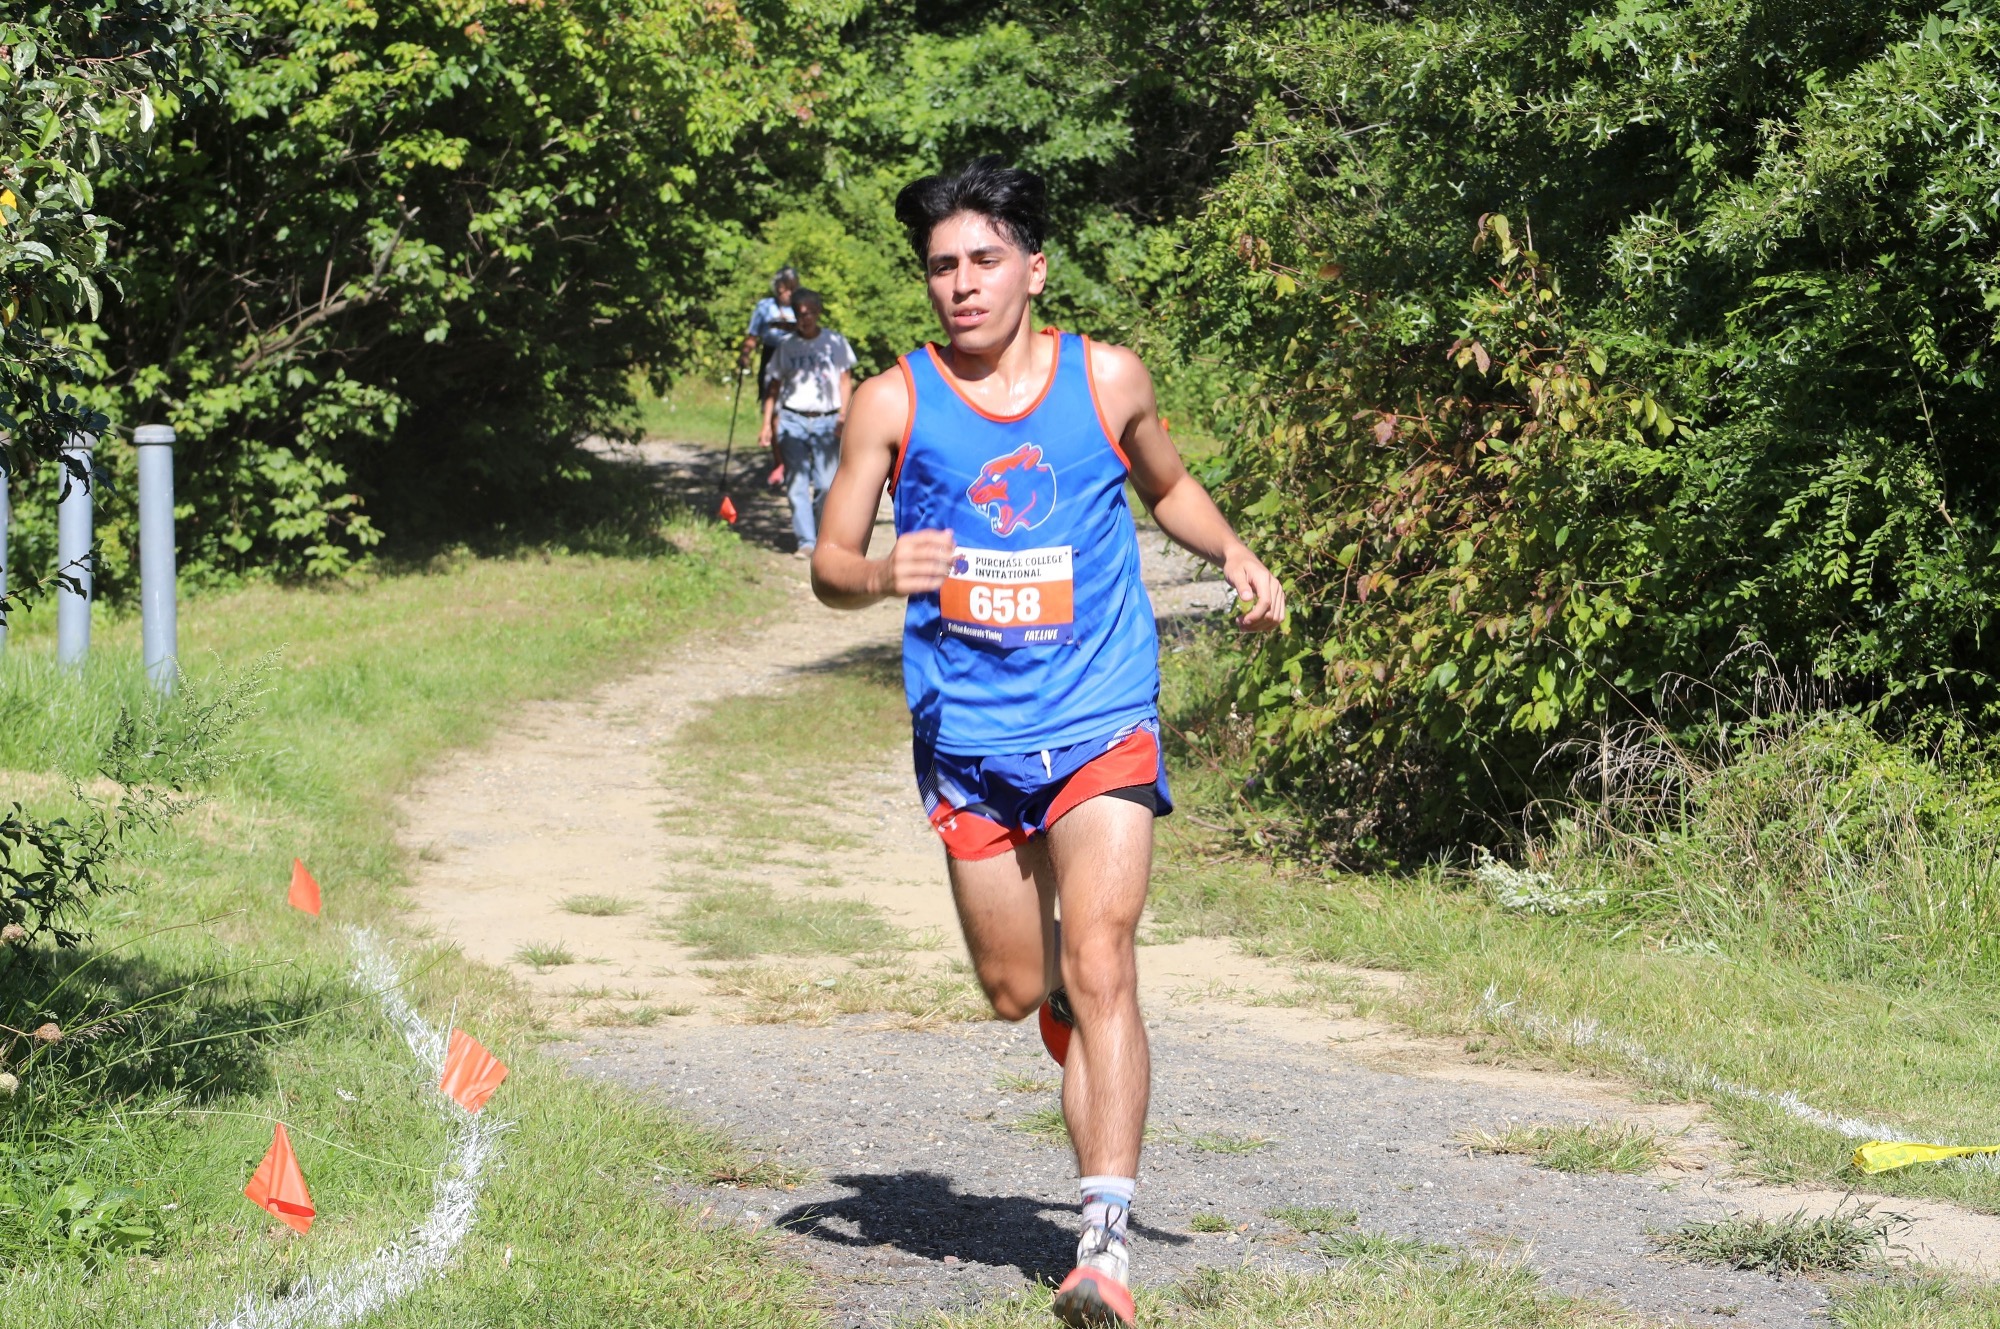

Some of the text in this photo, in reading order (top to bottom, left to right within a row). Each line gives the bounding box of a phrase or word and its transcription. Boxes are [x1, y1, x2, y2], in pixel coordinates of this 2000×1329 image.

[975, 554, 1064, 568] PURCHASE COLLEGE
[975, 568, 1042, 579] INVITATIONAL
[969, 585, 1041, 624] 658
[1024, 628, 1059, 642] FAT.LIVE
